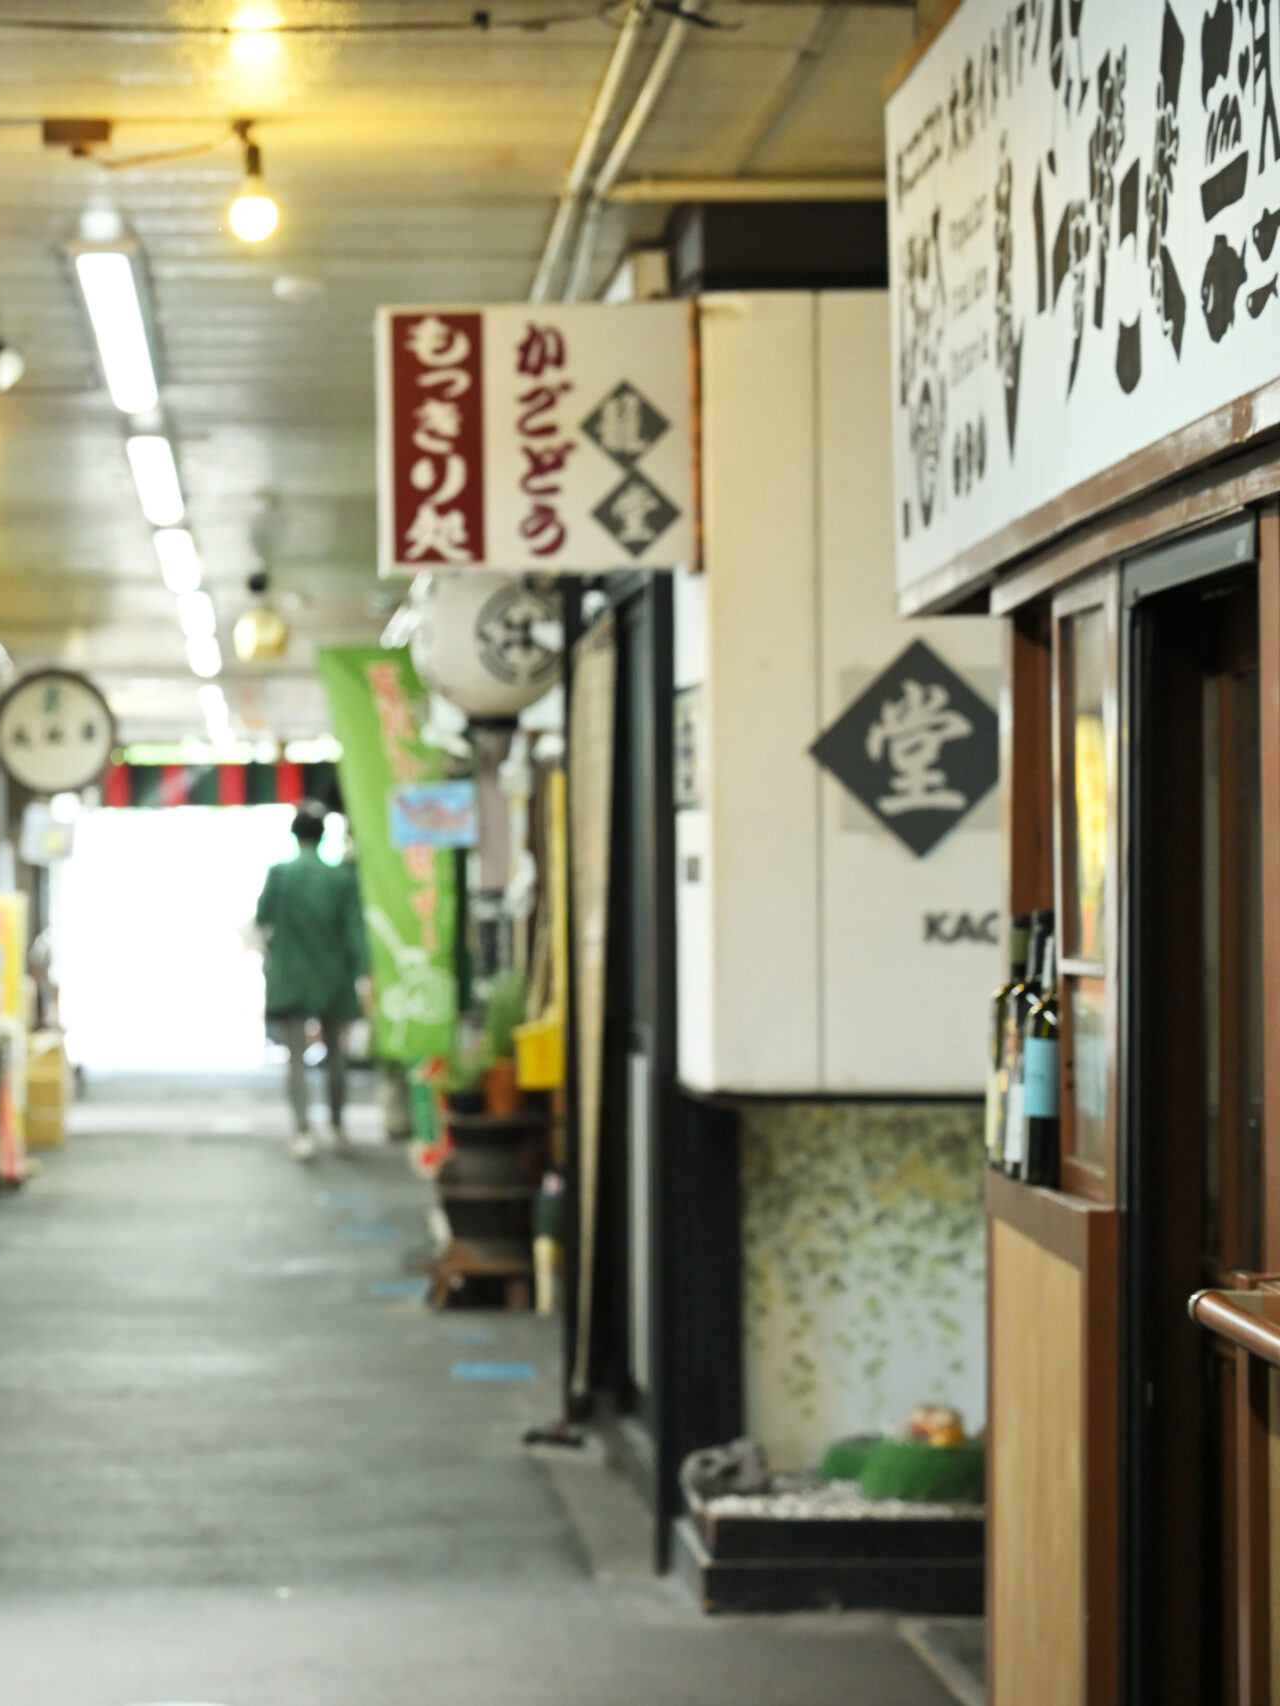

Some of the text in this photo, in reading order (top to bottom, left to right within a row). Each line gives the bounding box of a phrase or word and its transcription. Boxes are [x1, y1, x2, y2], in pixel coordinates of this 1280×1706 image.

[404, 315, 472, 561] もっきり処
[514, 321, 577, 557] かごどう
[864, 677, 973, 818] 堂
